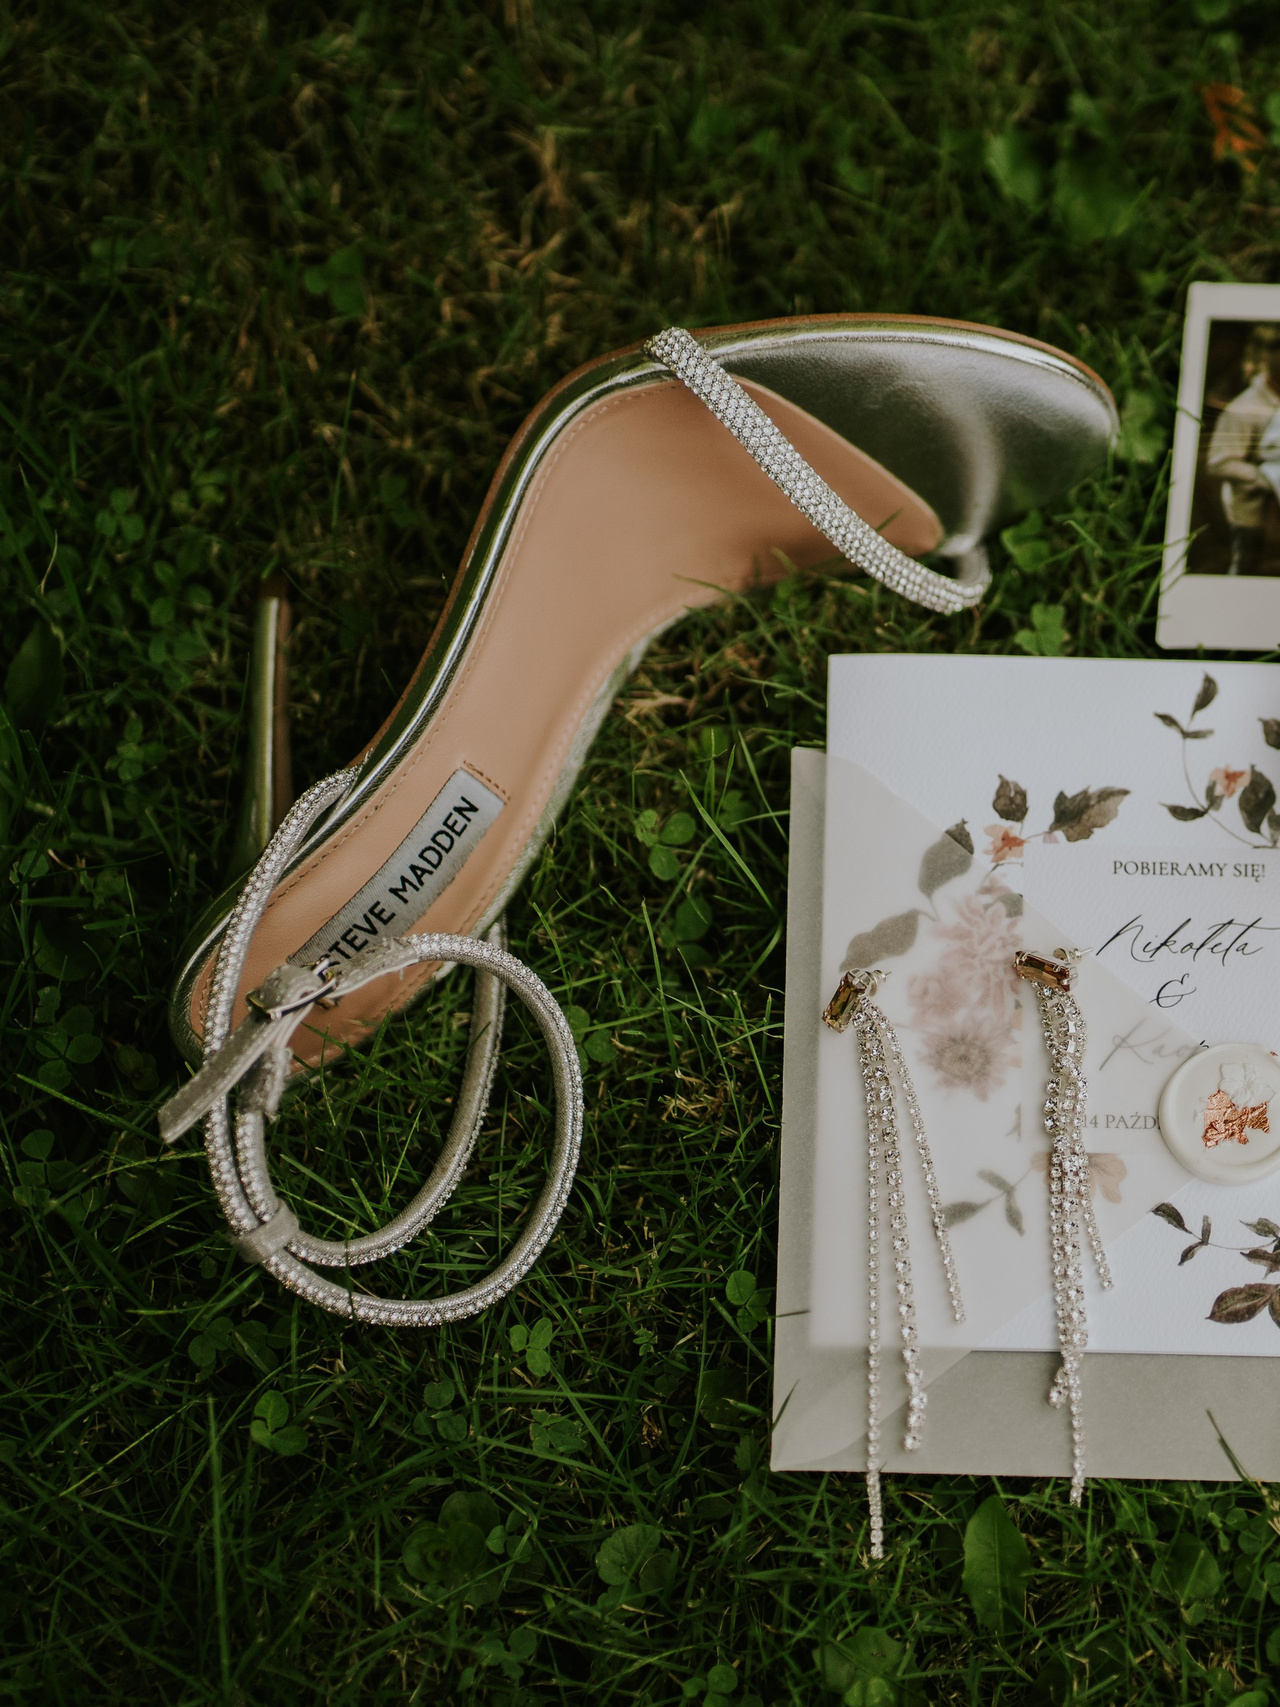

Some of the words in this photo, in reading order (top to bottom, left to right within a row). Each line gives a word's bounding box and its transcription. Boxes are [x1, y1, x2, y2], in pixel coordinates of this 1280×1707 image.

[388, 796, 479, 904] MADDEN
[1112, 859, 1229, 878] POBIERAMY
[1232, 862, 1267, 883] SIĘ!
[1149, 973, 1197, 1009] &
